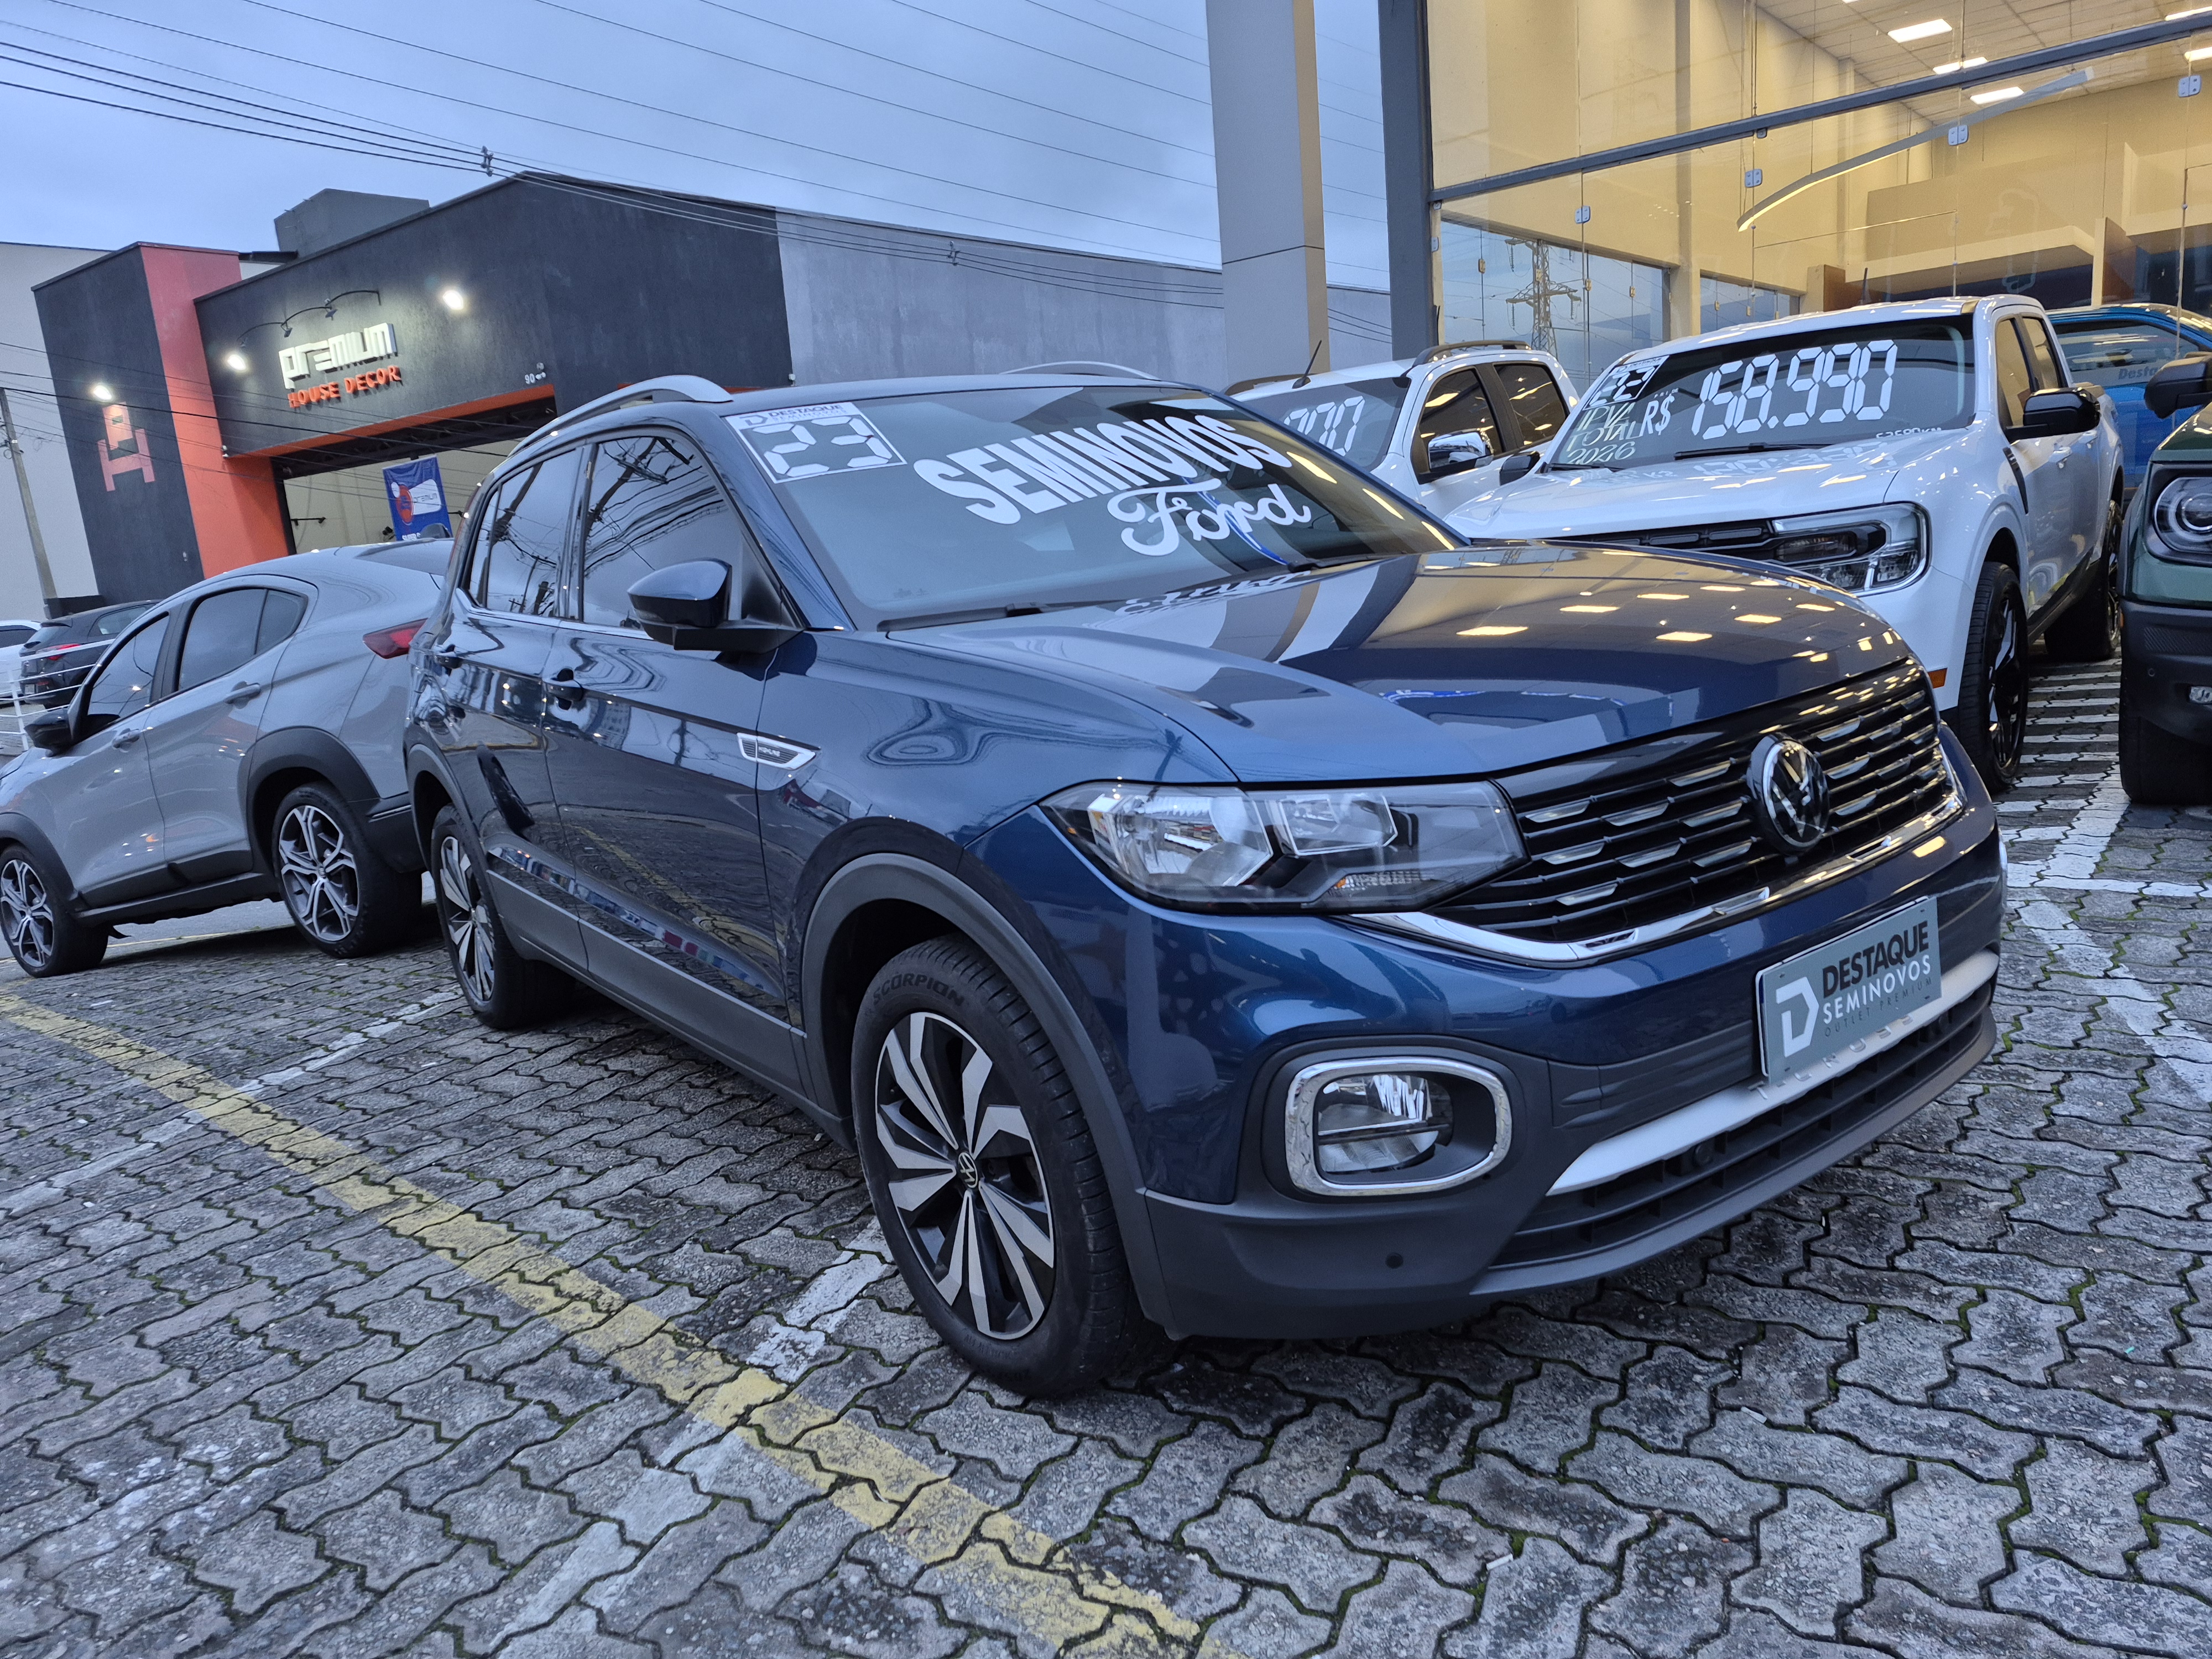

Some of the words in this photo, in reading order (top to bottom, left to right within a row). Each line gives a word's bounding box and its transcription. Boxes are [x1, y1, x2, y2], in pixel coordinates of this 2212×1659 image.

[288, 382, 341, 408] HOUSE
[344, 365, 403, 394] DECOR
[768, 405, 843, 416] DESTAQUE
[1691, 340, 1898, 440] 158.990
[1567, 419, 1643, 452] TOTAL
[1577, 401, 1636, 432] IPVA
[1639, 393, 1675, 436] R$
[753, 416, 893, 477] 23
[914, 415, 1293, 525] SEMINOVOS
[1567, 441, 1636, 465] 2026
[1107, 478, 1312, 556] Ford
[1823, 921, 1929, 999] DESTAQUE
[873, 973, 965, 1006] SCORPION
[1823, 954, 1931, 1024] SEMINOVOS
[1825, 1007, 1870, 1037] OUTLET
[1880, 977, 1932, 1010] PREMIUM
